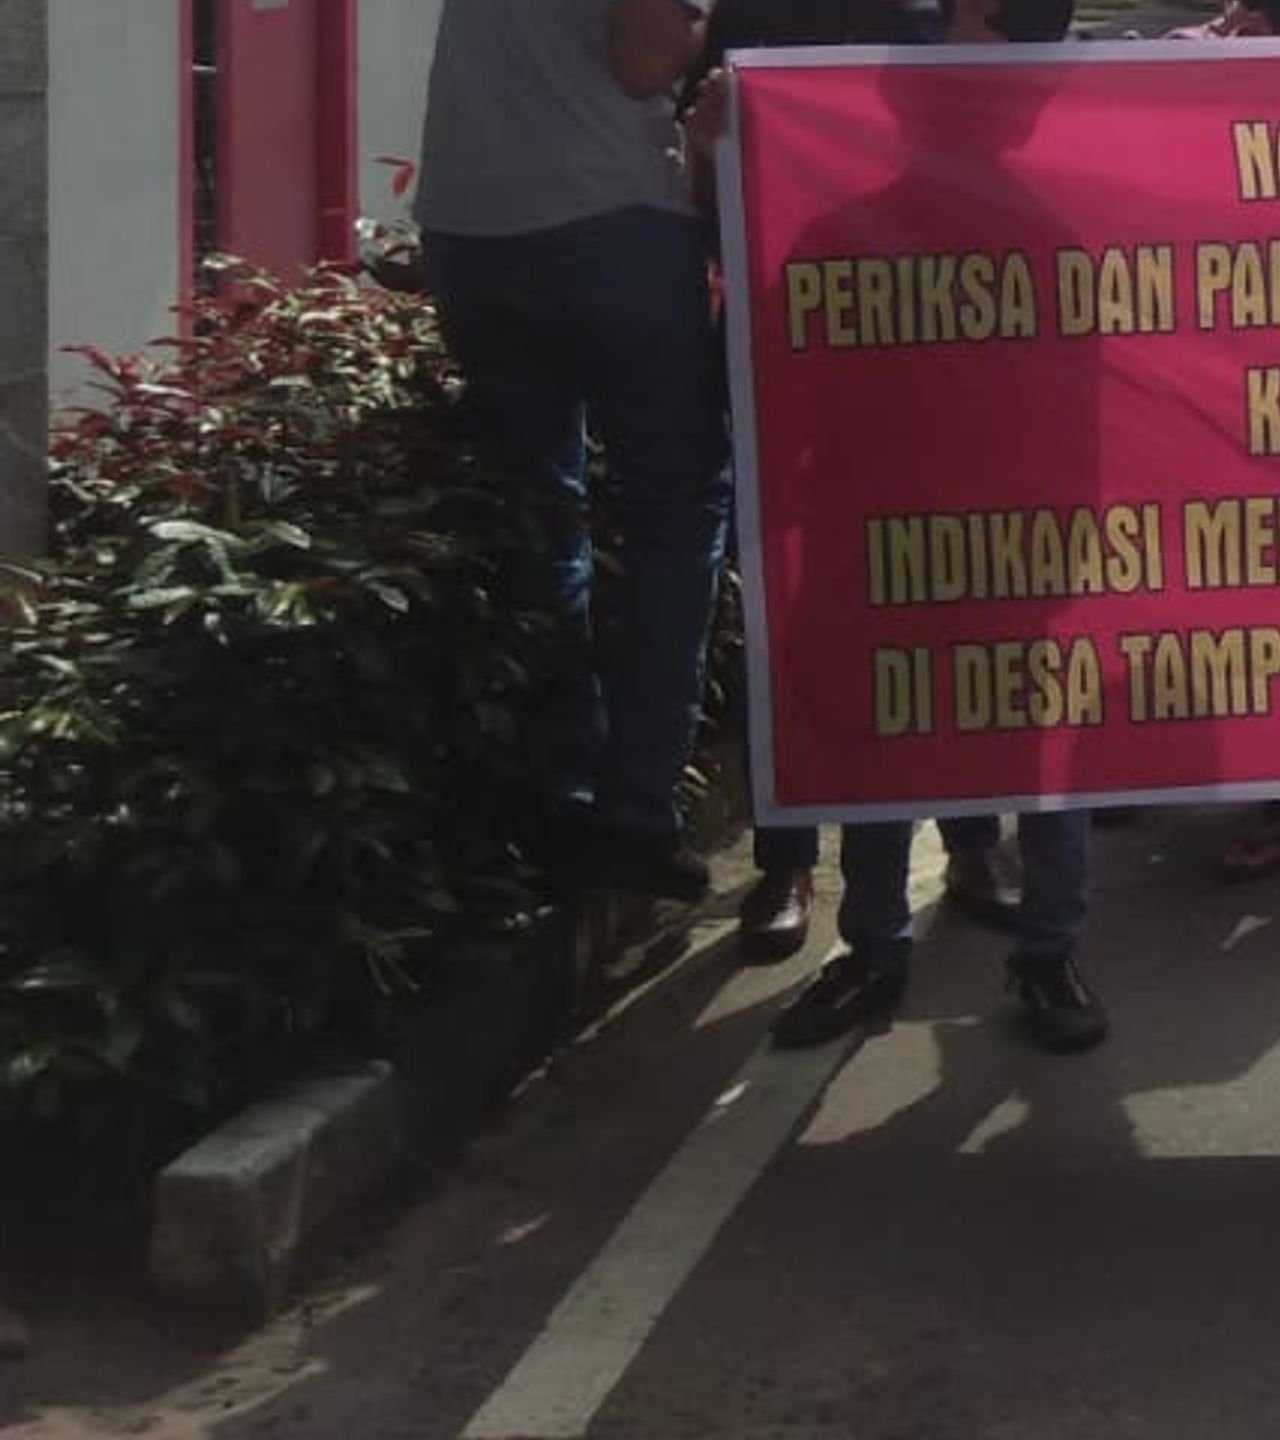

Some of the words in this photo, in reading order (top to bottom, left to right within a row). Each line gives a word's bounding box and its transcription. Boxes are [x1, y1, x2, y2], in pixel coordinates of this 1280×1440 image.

[787, 251, 1038, 349] PERIKSA
[1056, 243, 1176, 336] DAN
[866, 504, 1164, 606] INDIKAASI
[871, 645, 933, 738] DI
[955, 637, 1104, 732] DESA
